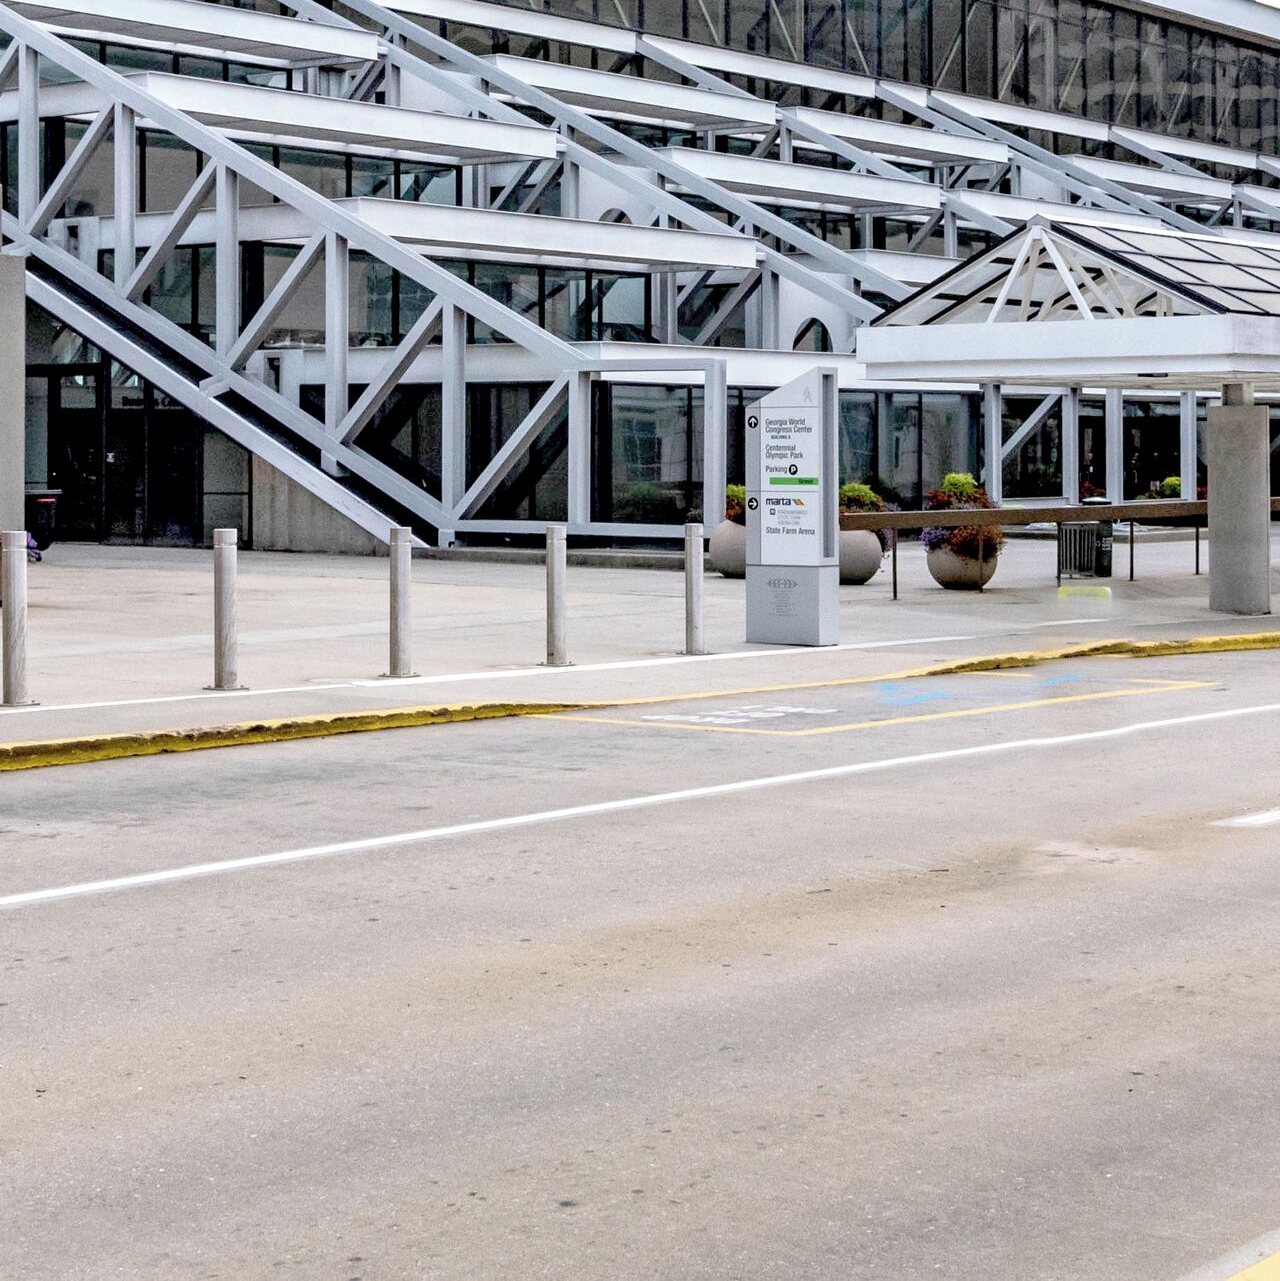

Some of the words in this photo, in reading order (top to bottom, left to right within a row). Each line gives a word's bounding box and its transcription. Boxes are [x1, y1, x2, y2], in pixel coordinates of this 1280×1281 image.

[765, 418, 787, 427] Georgia
[788, 418, 806, 426] World
[765, 425, 792, 434] Congress
[765, 444, 796, 452] Centennial
[765, 451, 789, 460] Olympic
[765, 465, 788, 474] Parking
[765, 498, 792, 506] marta
[766, 526, 781, 534] State
[782, 527, 797, 535] Farm
[798, 528, 816, 536] Arena
